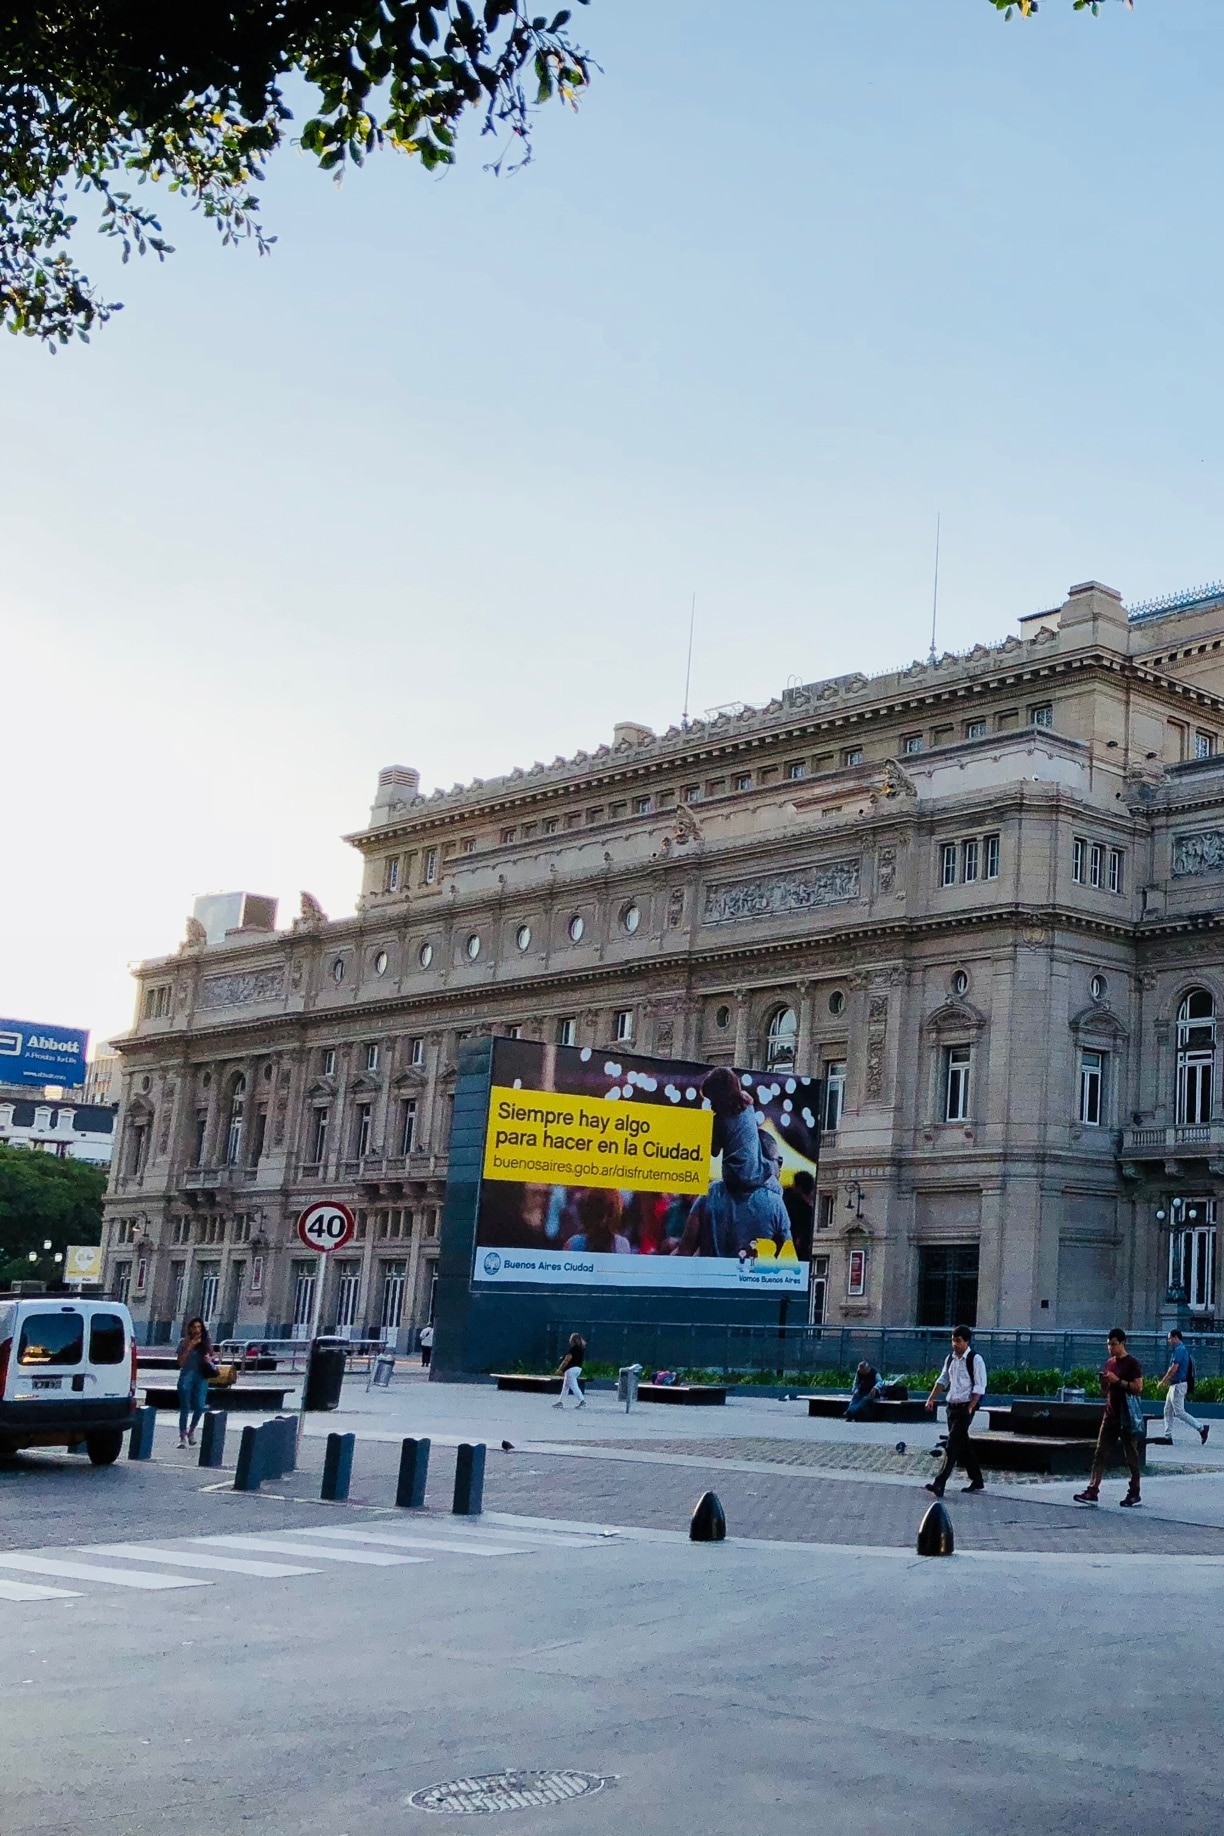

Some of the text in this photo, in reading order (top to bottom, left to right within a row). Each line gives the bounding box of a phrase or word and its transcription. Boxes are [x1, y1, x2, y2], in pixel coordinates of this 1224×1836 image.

[26, 1035, 80, 1054] Abbott
[498, 1102, 650, 1137] Siempre hay algo
[495, 1129, 704, 1162] para hacer en la Ciudad.
[493, 1154, 701, 1184] buenosaires.gob.ar/disfrutemosBA
[307, 1214, 346, 1239] 40
[504, 1259, 594, 1273] Buenos Aires Ciudad
[739, 1275, 801, 1285] Vamos Buenos Aires
